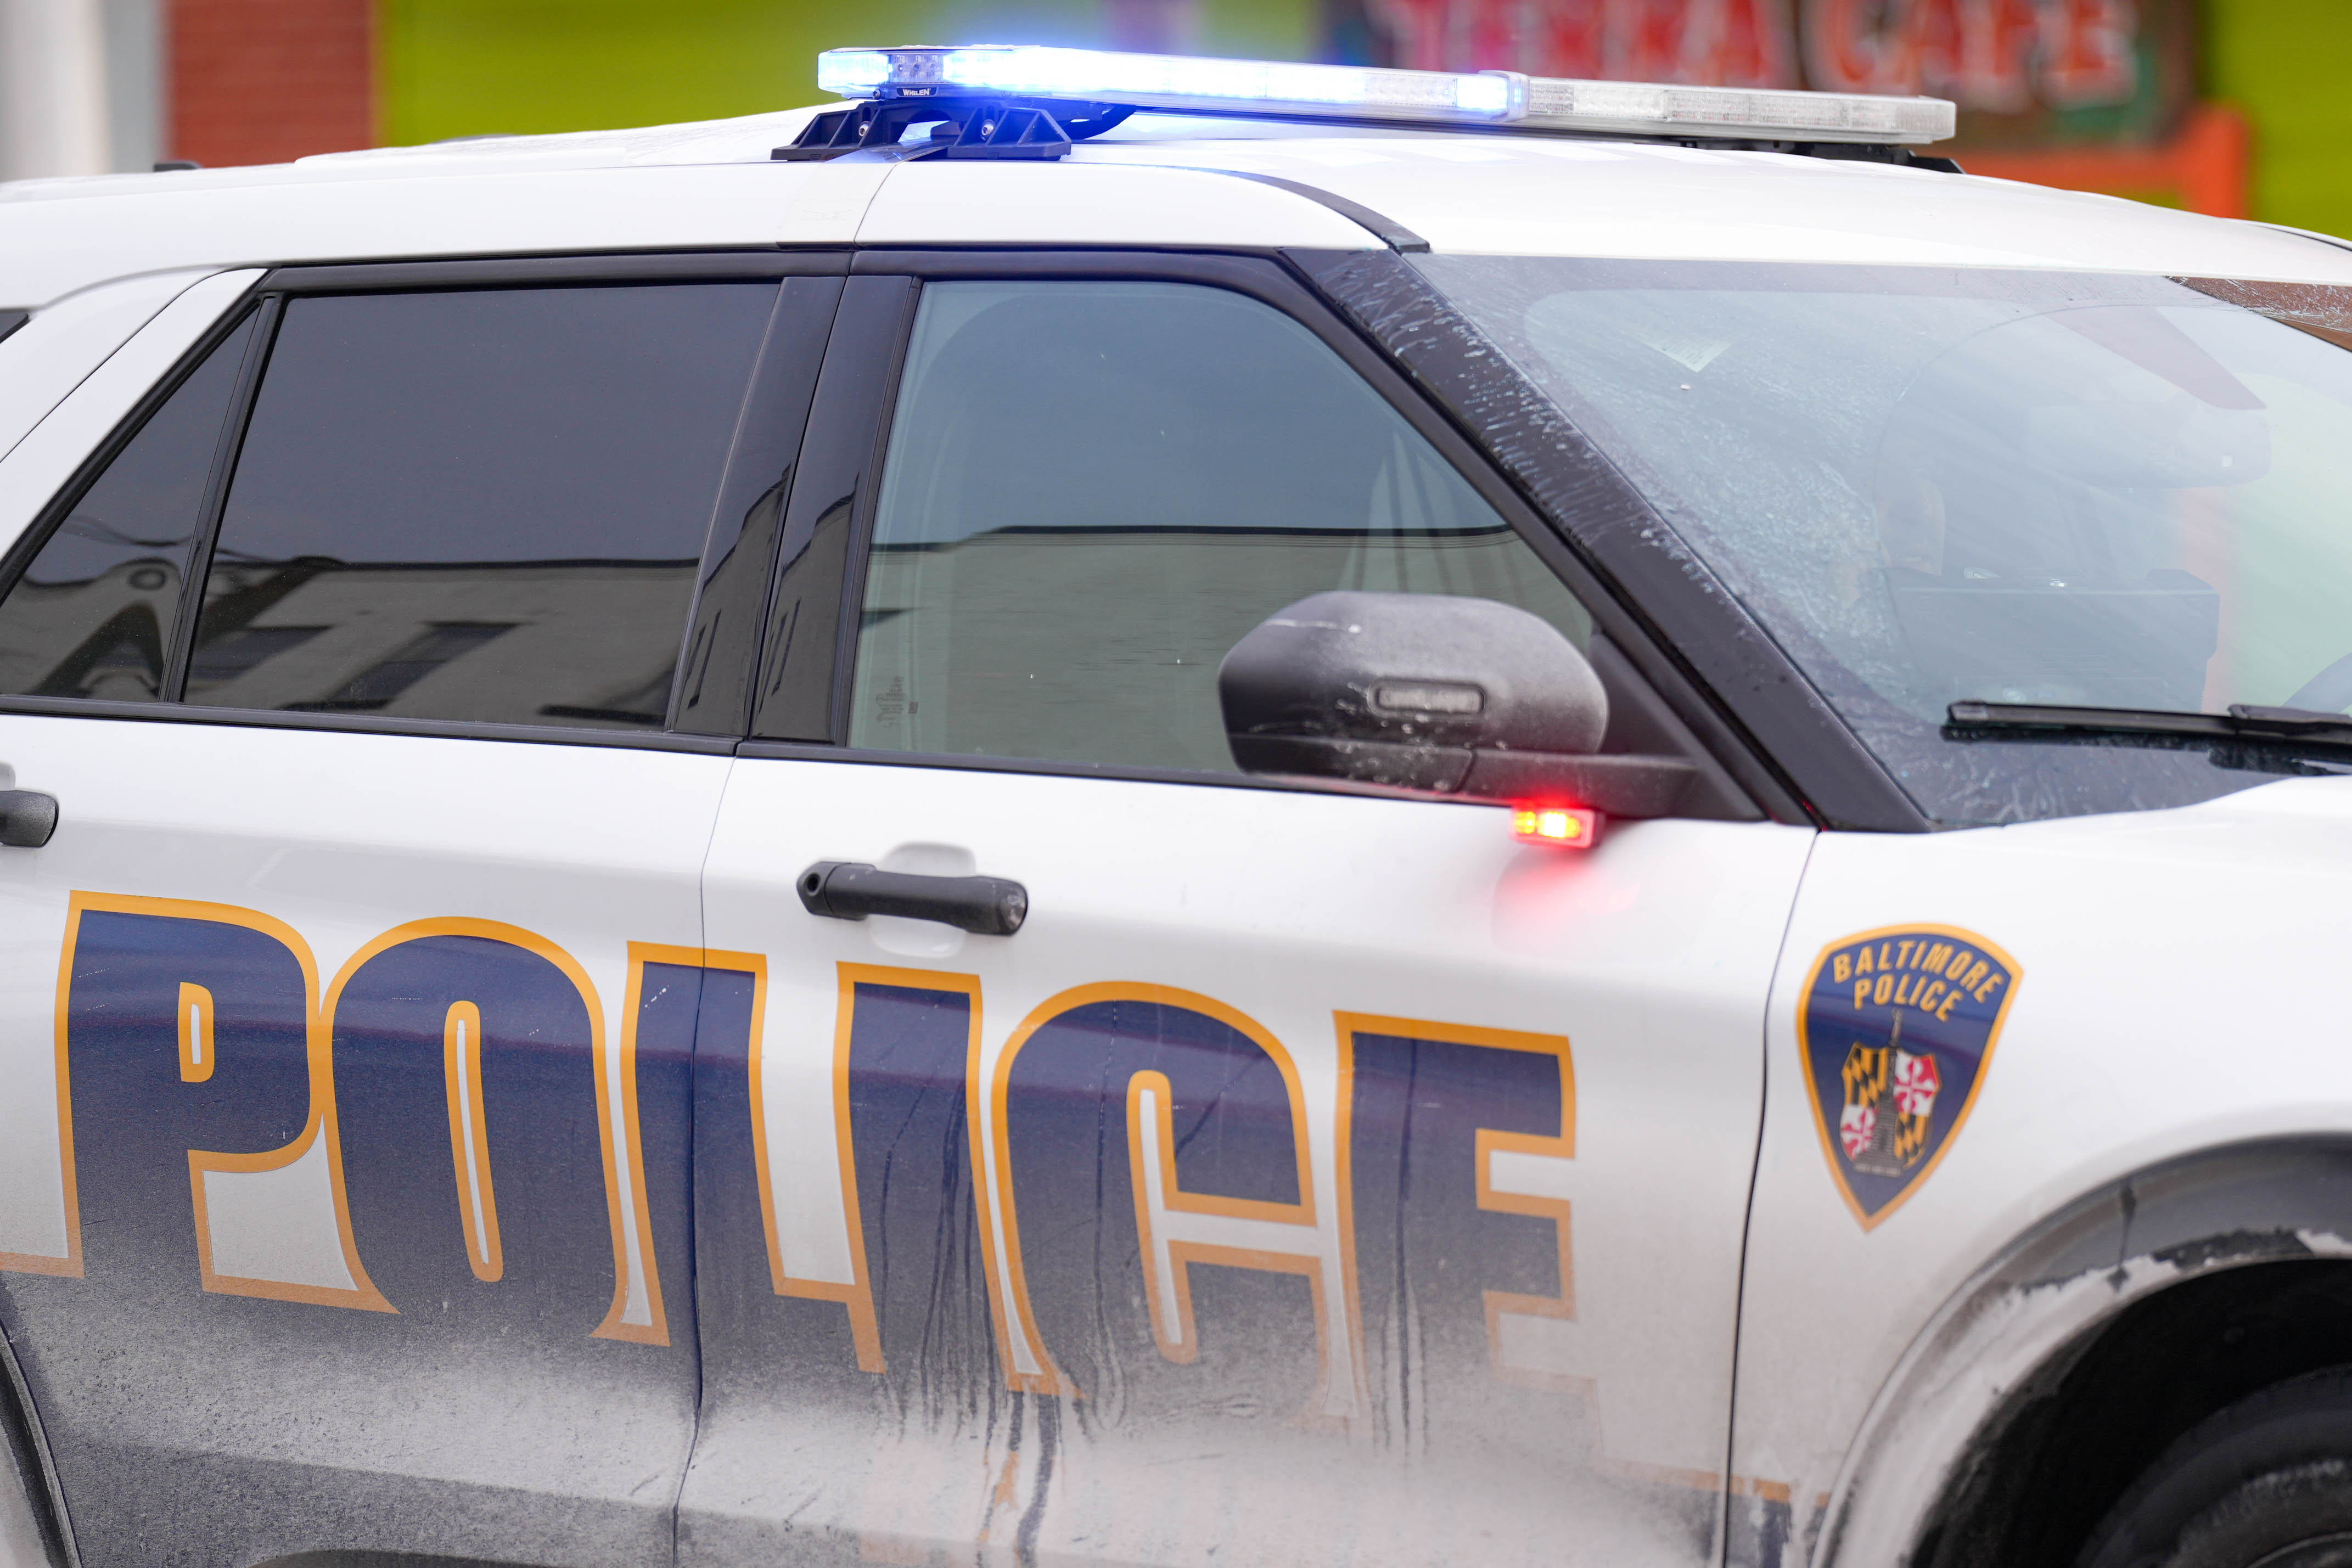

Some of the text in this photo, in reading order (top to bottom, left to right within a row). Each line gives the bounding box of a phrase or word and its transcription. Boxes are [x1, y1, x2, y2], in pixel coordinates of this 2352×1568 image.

[1833, 940, 2003, 1003] BALTIMORE
[1854, 974, 1963, 1021] POLICE
[52, 889, 1578, 1421] POLICE
